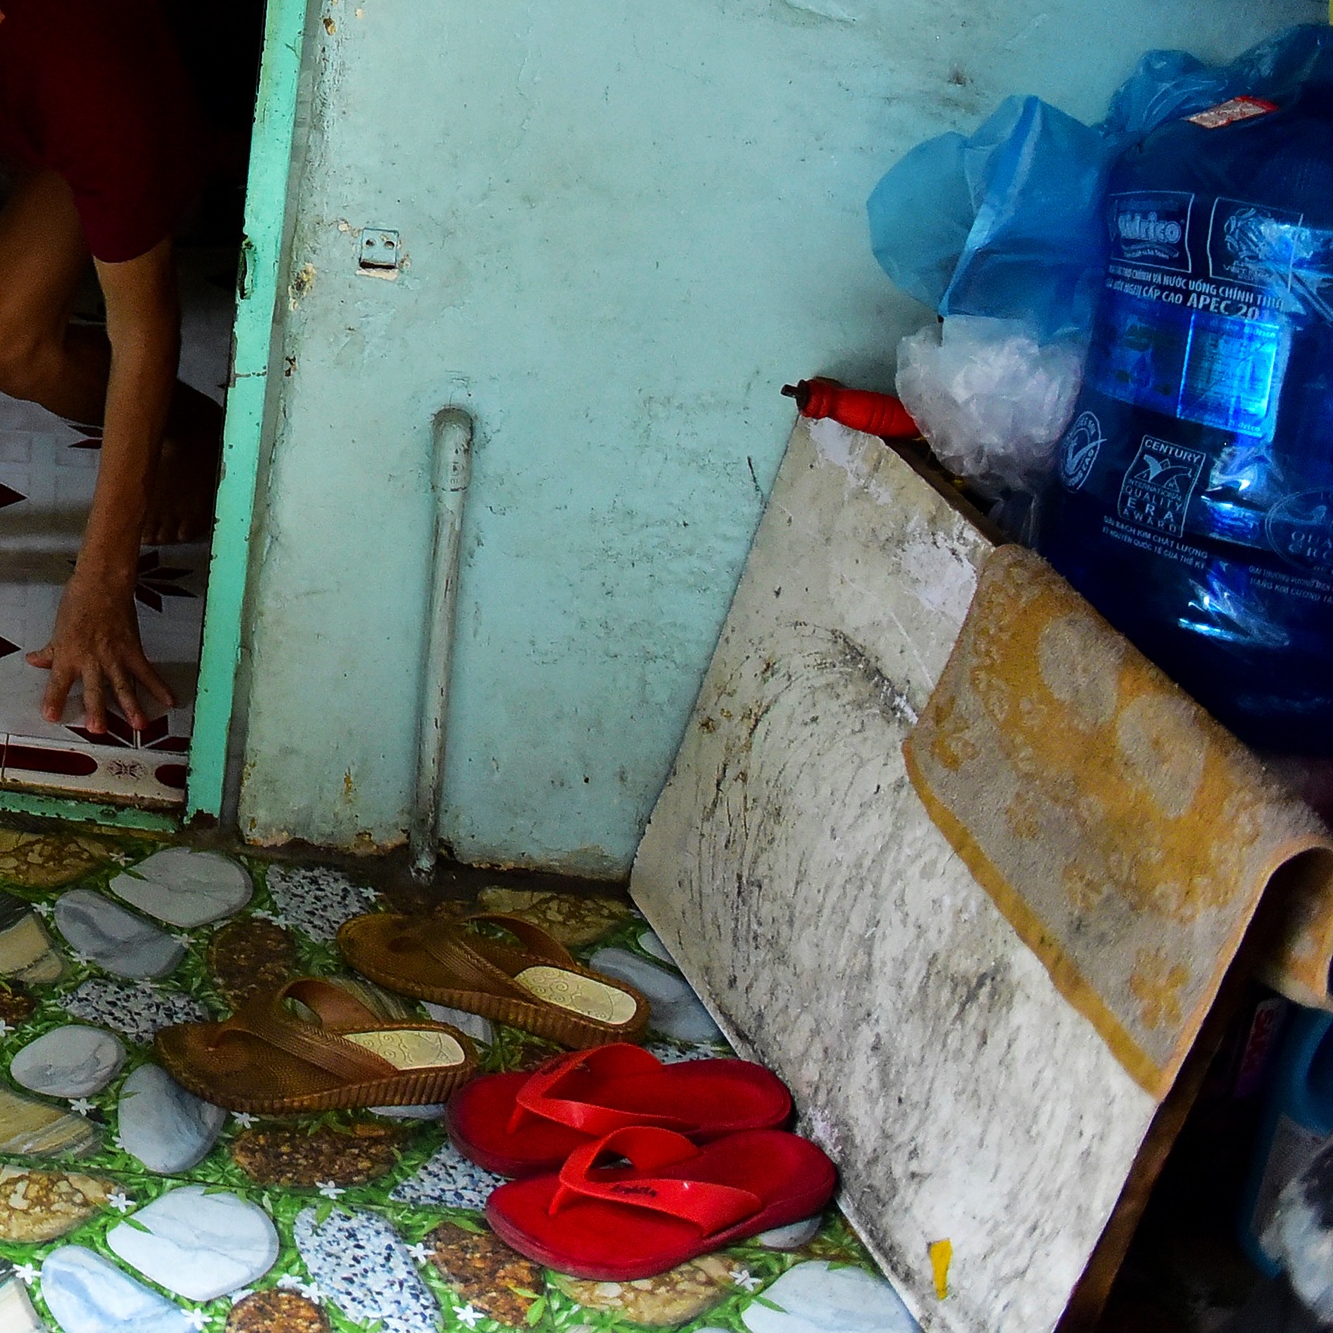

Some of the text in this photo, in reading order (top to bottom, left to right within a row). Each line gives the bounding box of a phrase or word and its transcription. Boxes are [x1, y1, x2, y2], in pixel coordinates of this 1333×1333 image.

[1142, 284, 1161, 300] CẤP
[1161, 291, 1183, 304] CAO
[1186, 292, 1232, 315] APEC
[1162, 274, 1187, 289] NƯỚC
[1188, 278, 1217, 295] UỐNG
[1218, 286, 1254, 303] CHÍNH
[1144, 438, 1202, 464] CENTURY
[1124, 485, 1183, 512] QUALITY
[1126, 496, 1174, 523] ERA
[1122, 507, 1177, 534] AWARD
[1136, 528, 1152, 540] KIM
